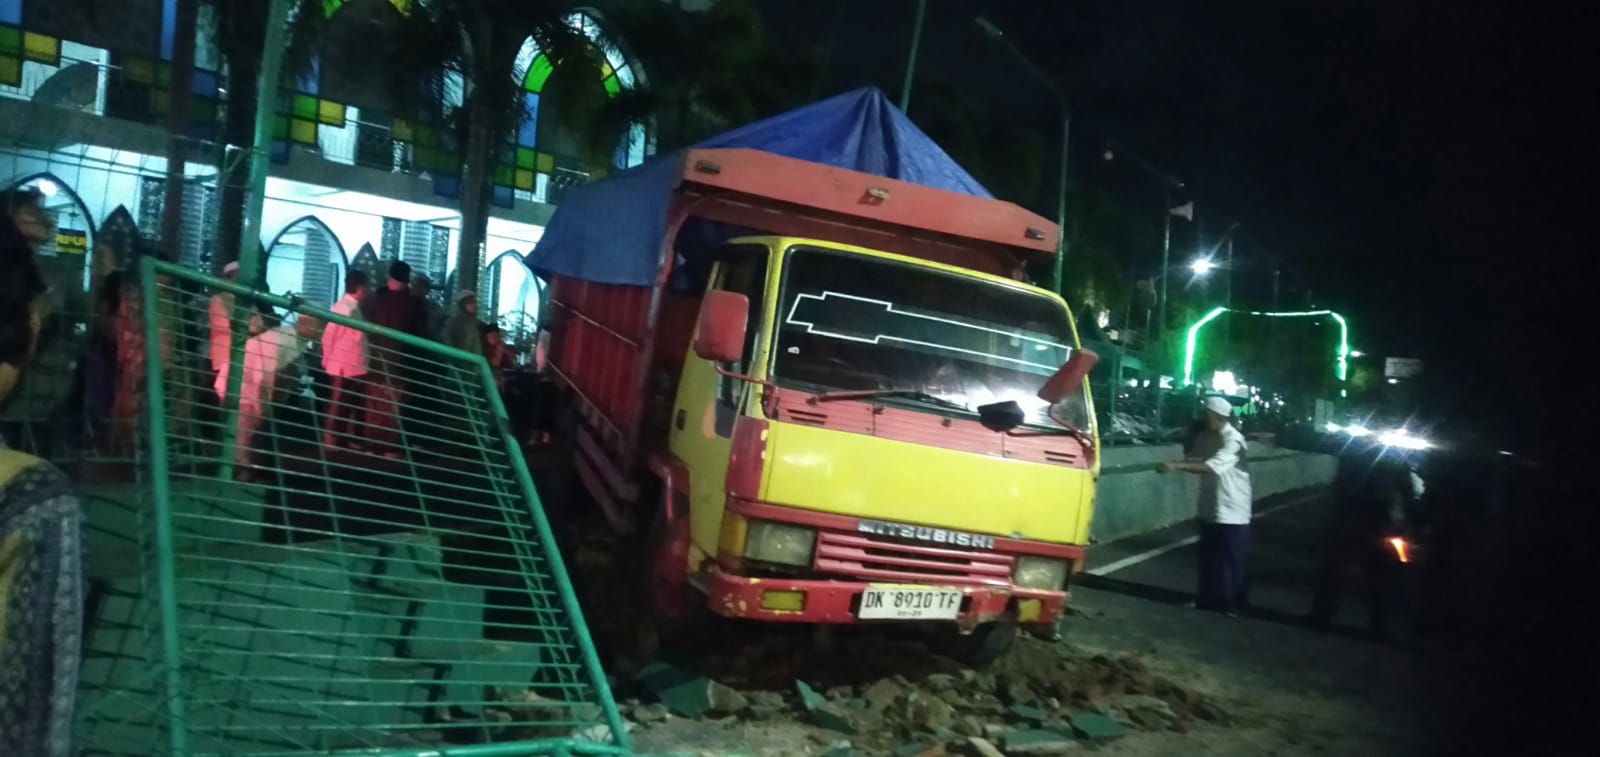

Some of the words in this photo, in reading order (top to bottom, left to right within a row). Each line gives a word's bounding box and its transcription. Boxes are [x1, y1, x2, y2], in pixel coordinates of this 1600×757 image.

[857, 519, 996, 549] MITSUBISHI
[864, 591, 885, 609] DK
[893, 591, 934, 609] 8910
[938, 592, 959, 609] TF
